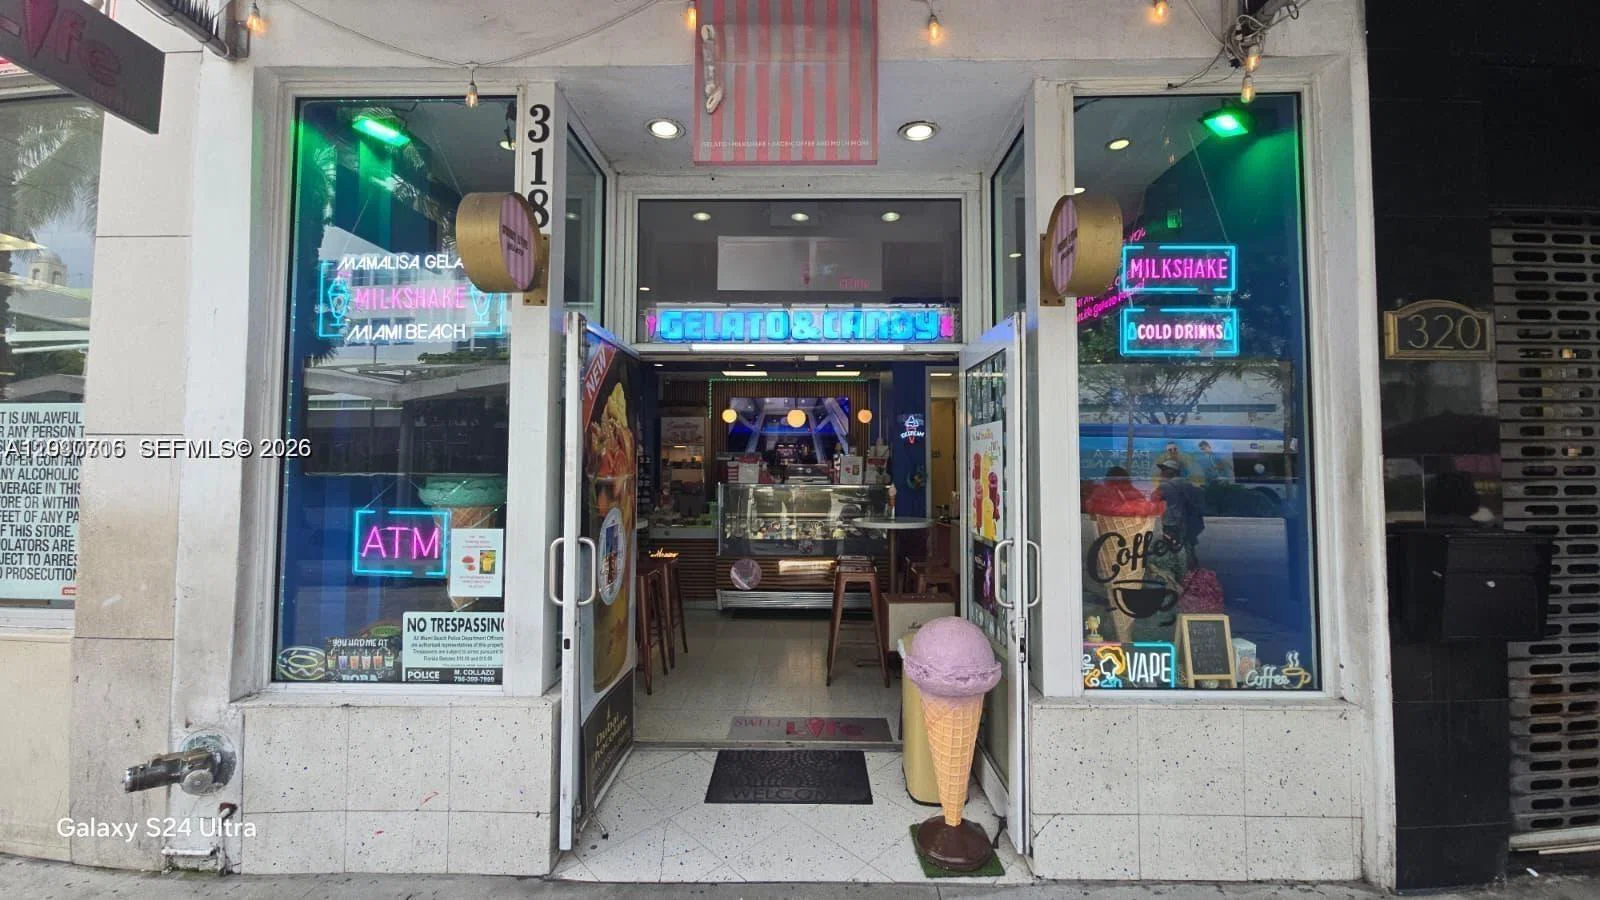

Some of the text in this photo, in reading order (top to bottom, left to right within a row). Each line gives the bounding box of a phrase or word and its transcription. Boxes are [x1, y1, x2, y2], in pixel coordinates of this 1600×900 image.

[527, 103, 551, 229] 318
[337, 254, 420, 271] MAMALISA
[1130, 258, 1228, 279] MILKSHAKE
[355, 286, 467, 312] MILKSHAKE
[347, 323, 466, 341] MIAMI BEACH
[659, 310, 940, 341] GELATO & CANDY
[1137, 323, 1224, 340] COLD DRINKS
[1407, 314, 1481, 349] 320
[586, 342, 607, 401] NEW
[9, 411, 18, 424] IS
[21, 411, 82, 425] UNLAWFUL
[7, 425, 29, 438] ANY
[32, 425, 76, 439] PERSON
[18, 467, 79, 481] ALCOHOLIC
[45, 482, 56, 495] IN
[0, 496, 80, 509] ORE OR WITHIN
[24, 510, 38, 523] OF
[40, 511, 64, 523] ANY
[9, 524, 32, 537] THIS
[35, 524, 74, 538] STORE.
[52, 539, 75, 552] ARE
[361, 526, 439, 560] ATM
[27, 553, 41, 566] TO
[1087, 530, 1183, 583] Coffee
[407, 617, 427, 633] NO
[377, 638, 389, 647] AT
[407, 670, 440, 679] POLICE
[1126, 652, 1171, 683] VAPE
[1245, 664, 1290, 690] Coffee
[732, 787, 838, 801] WELCOM
